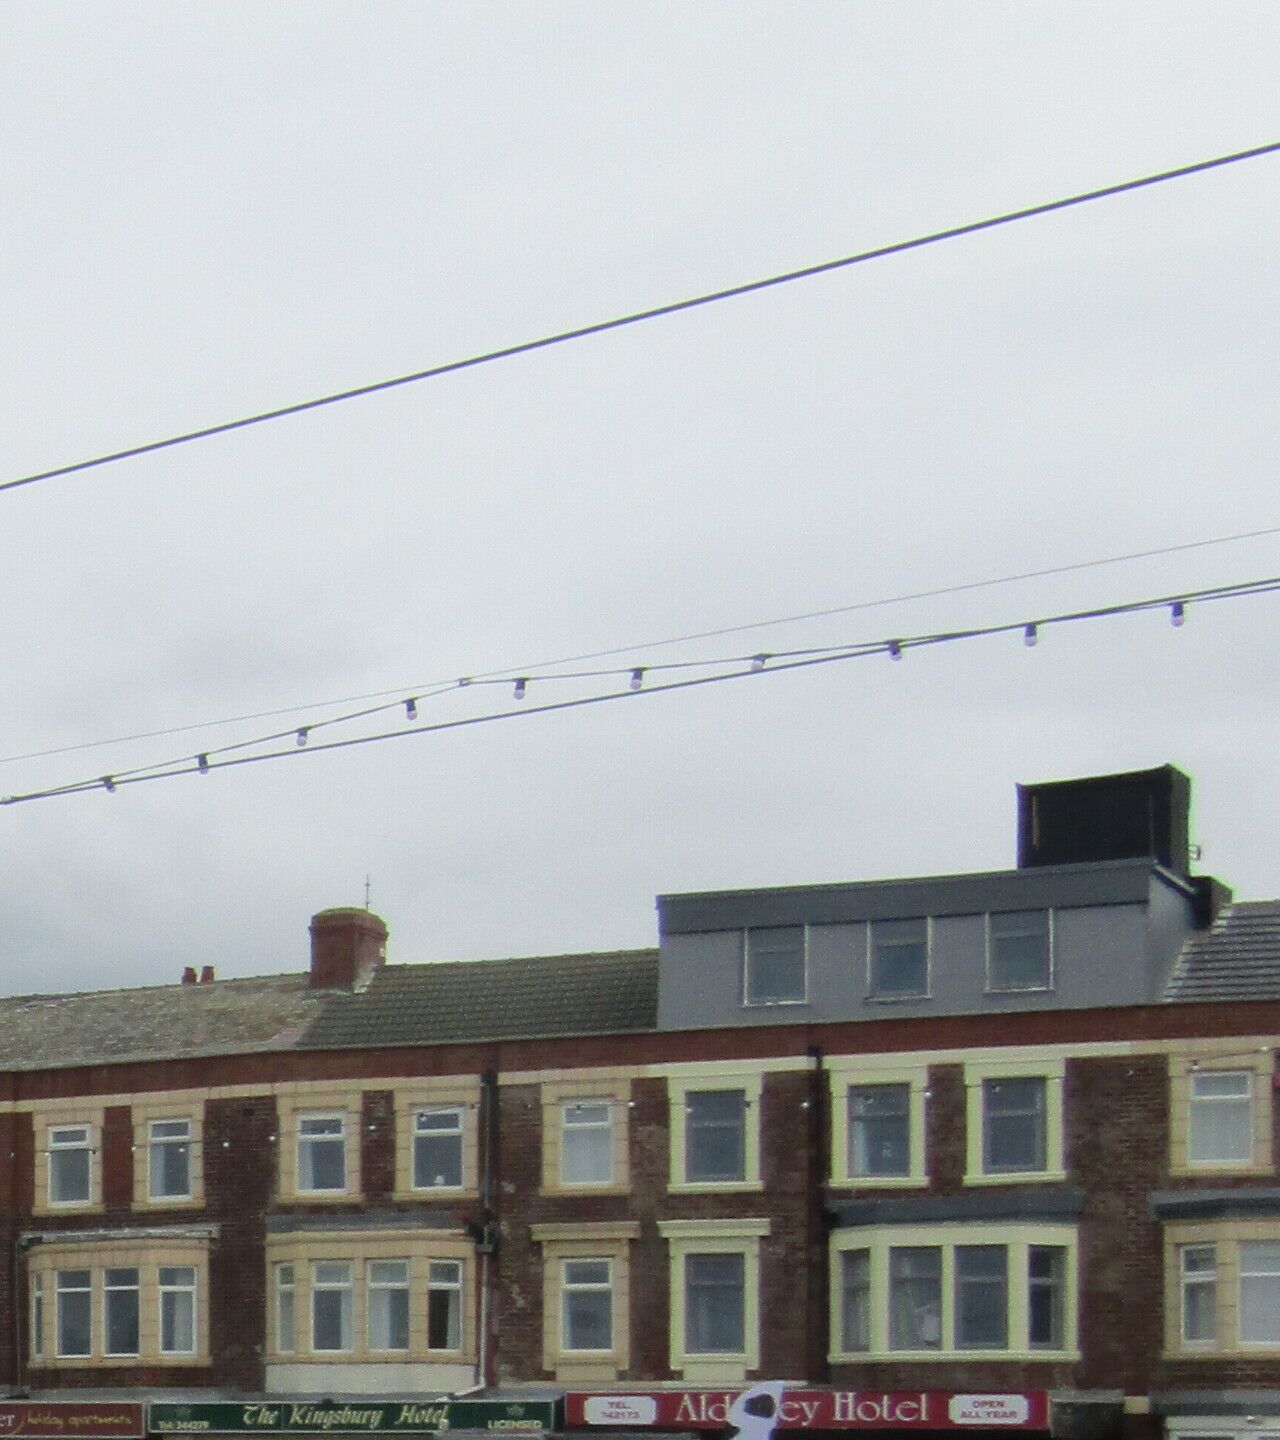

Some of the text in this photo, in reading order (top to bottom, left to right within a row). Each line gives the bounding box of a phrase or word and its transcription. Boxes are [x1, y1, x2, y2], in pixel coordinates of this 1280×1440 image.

[675, 1392, 929, 1426] Aldey Hotel
[972, 1400, 1005, 1409] OPEN
[243, 1404, 450, 1430] The Kingsbury Hotel
[960, 1410, 1017, 1418] ALL YEAR
